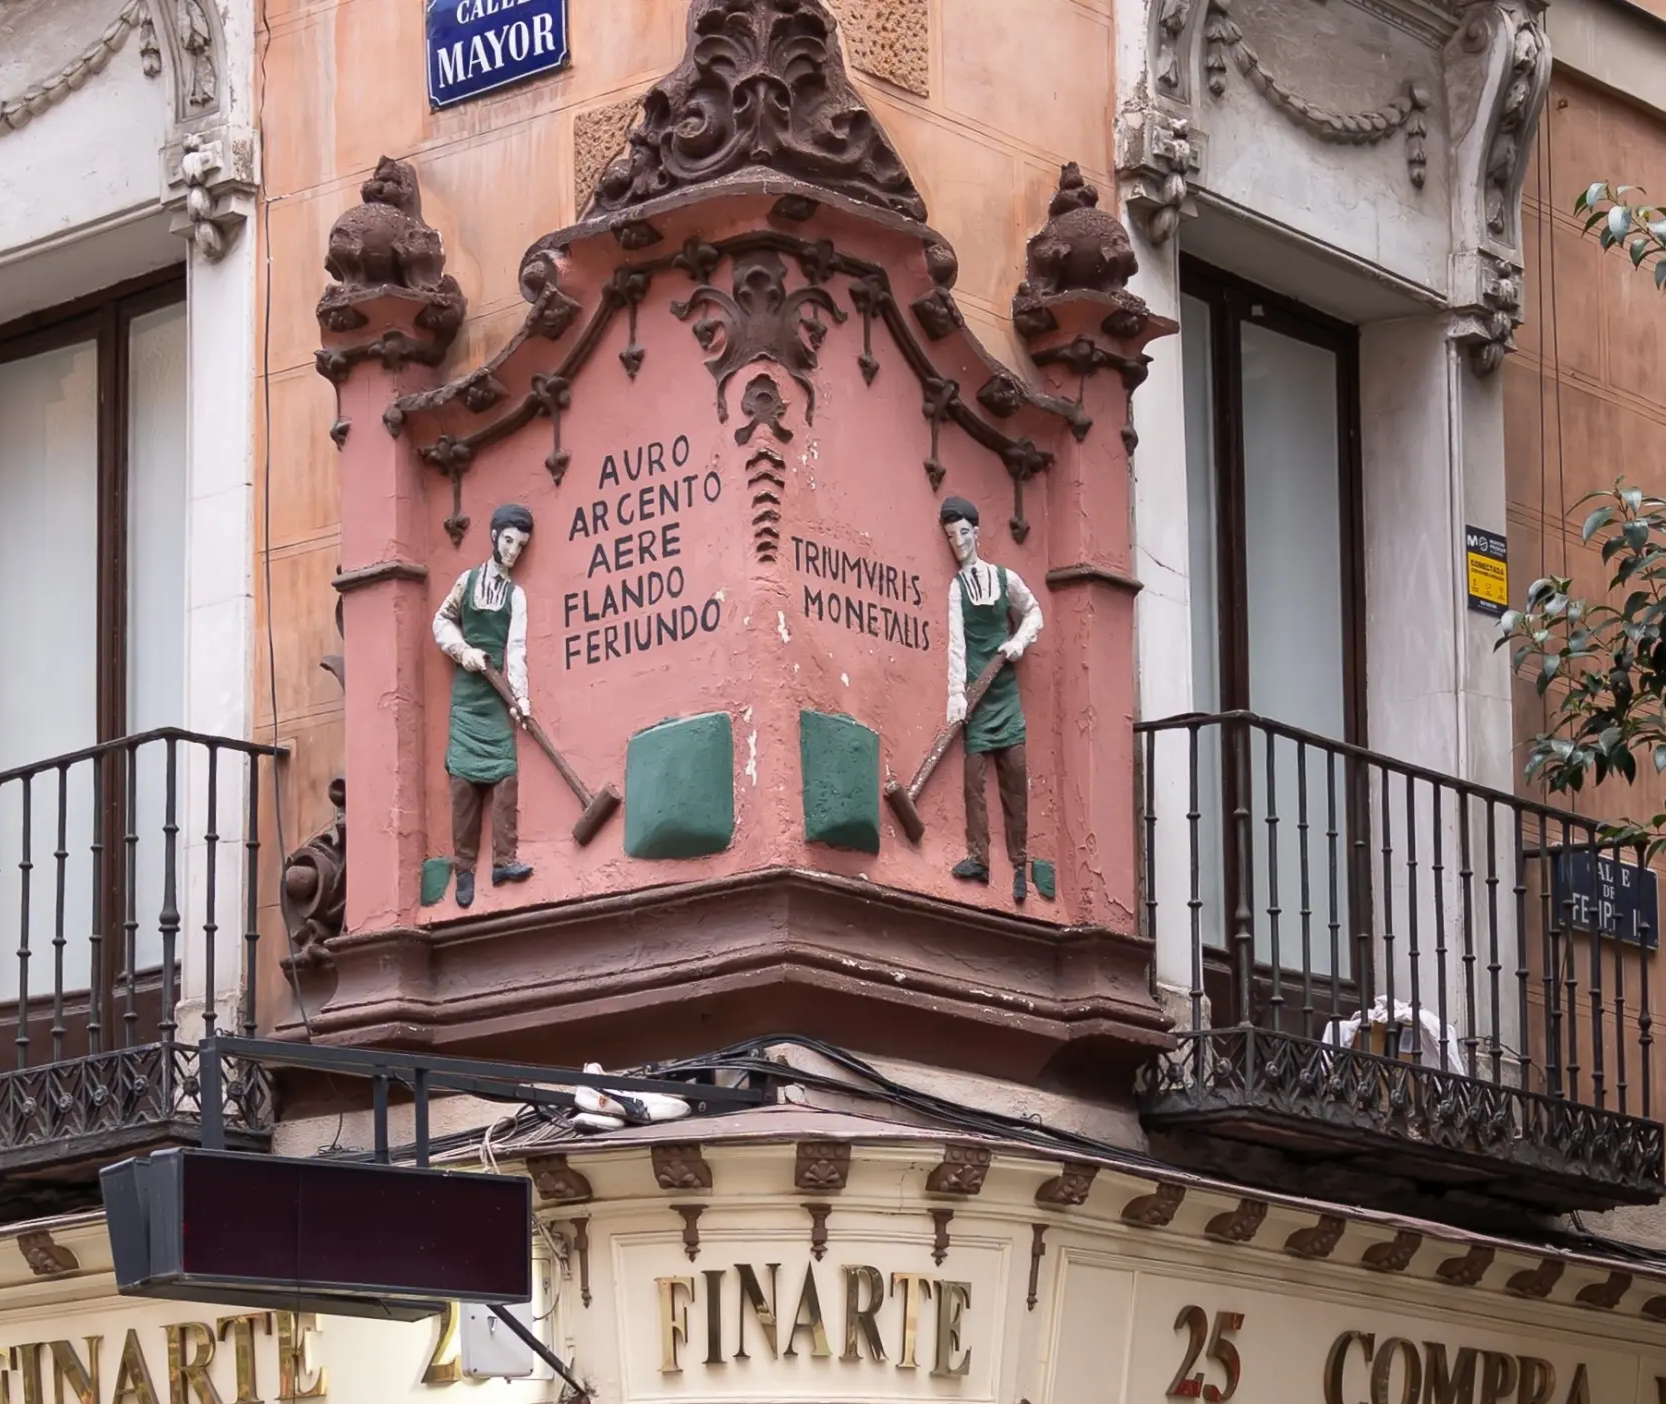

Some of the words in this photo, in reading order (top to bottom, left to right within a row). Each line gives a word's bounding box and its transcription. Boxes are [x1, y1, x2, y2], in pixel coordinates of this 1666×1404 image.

[437, 12, 556, 89] MAYOR
[598, 434, 690, 490] AURO
[587, 521, 681, 579] AERE
[791, 535, 922, 606] TRIUMVIRIS
[563, 565, 685, 628] FLANDO
[804, 584, 930, 652] MONETALIS
[564, 598, 721, 671] FERIUNDO
[654, 1261, 973, 1379] FINARTE
[1166, 1305, 1246, 1404] 25
